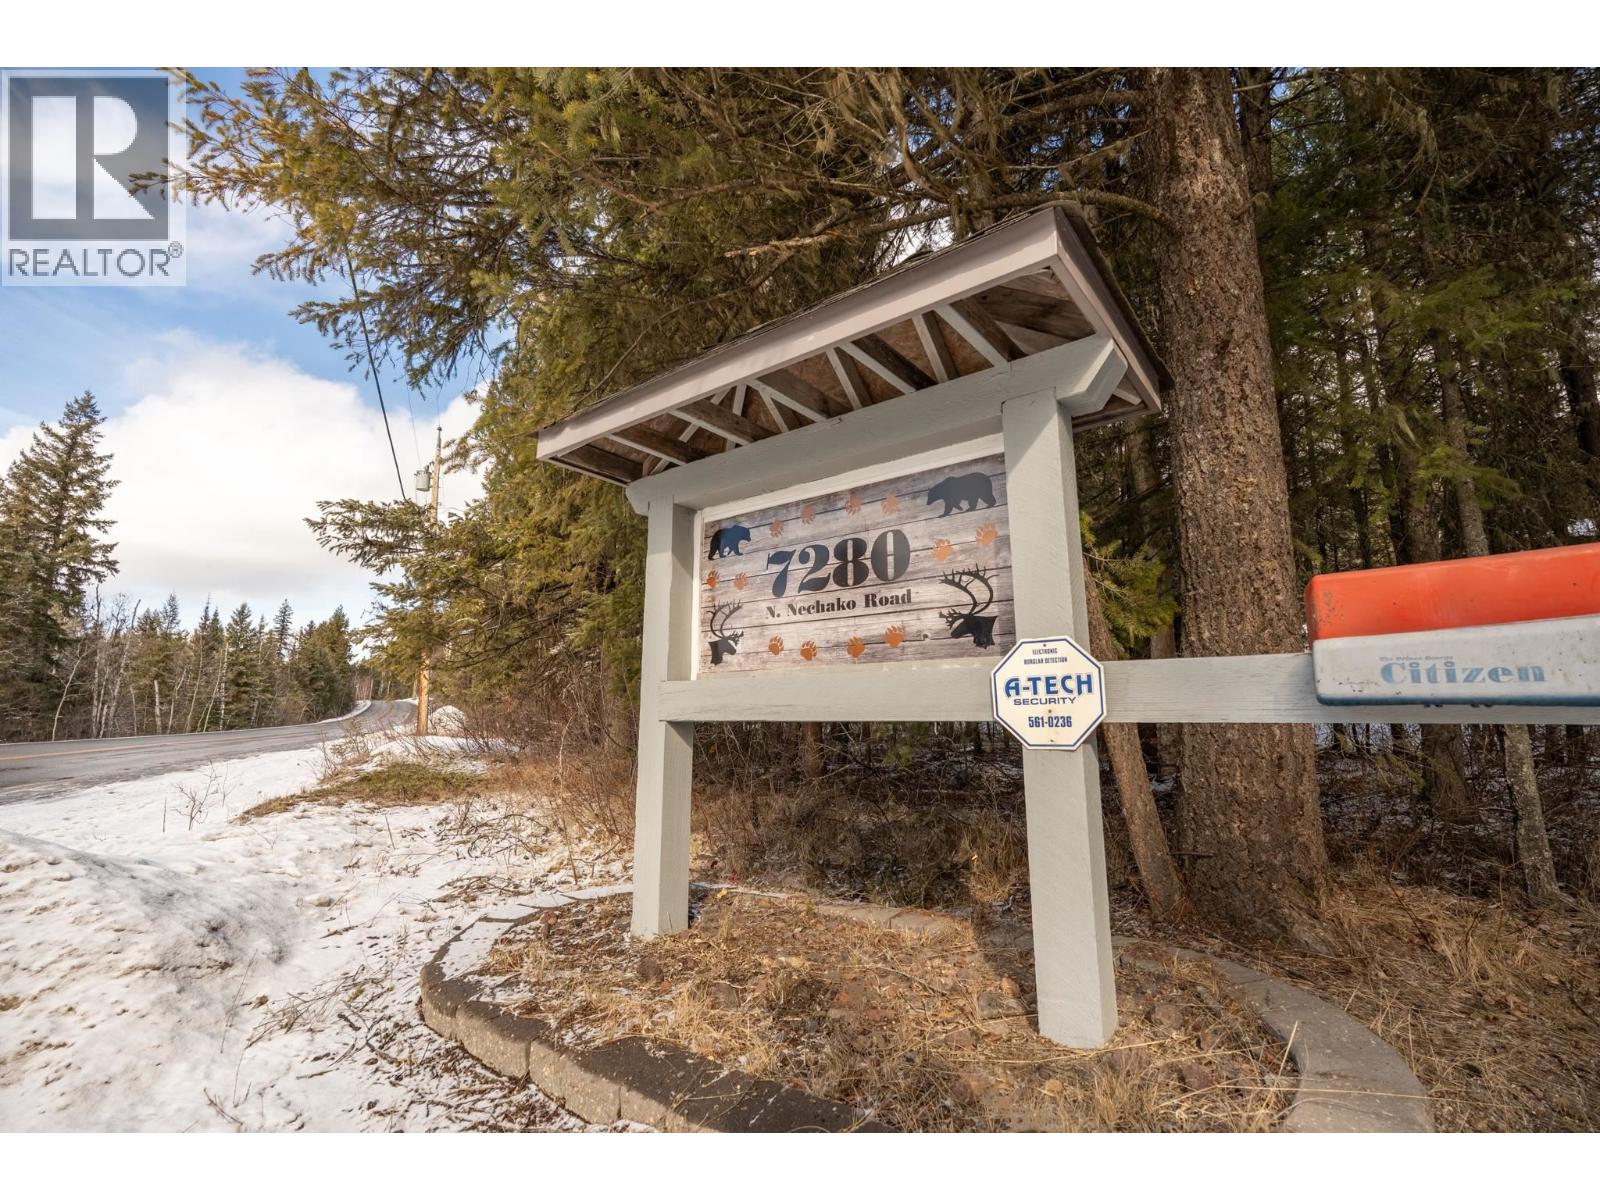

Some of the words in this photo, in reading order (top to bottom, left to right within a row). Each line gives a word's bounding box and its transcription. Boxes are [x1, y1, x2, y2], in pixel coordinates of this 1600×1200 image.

[766, 528, 911, 598] 7280
[766, 605, 781, 619] N.
[787, 597, 857, 617] Nechako
[863, 588, 912, 608] Road
[1044, 656, 1068, 664] DETECTION
[1380, 660, 1545, 685] Citizen
[1004, 673, 1093, 698] A-TECH
[1013, 696, 1077, 706] SECURITY
[1028, 715, 1073, 728] 561-0236
